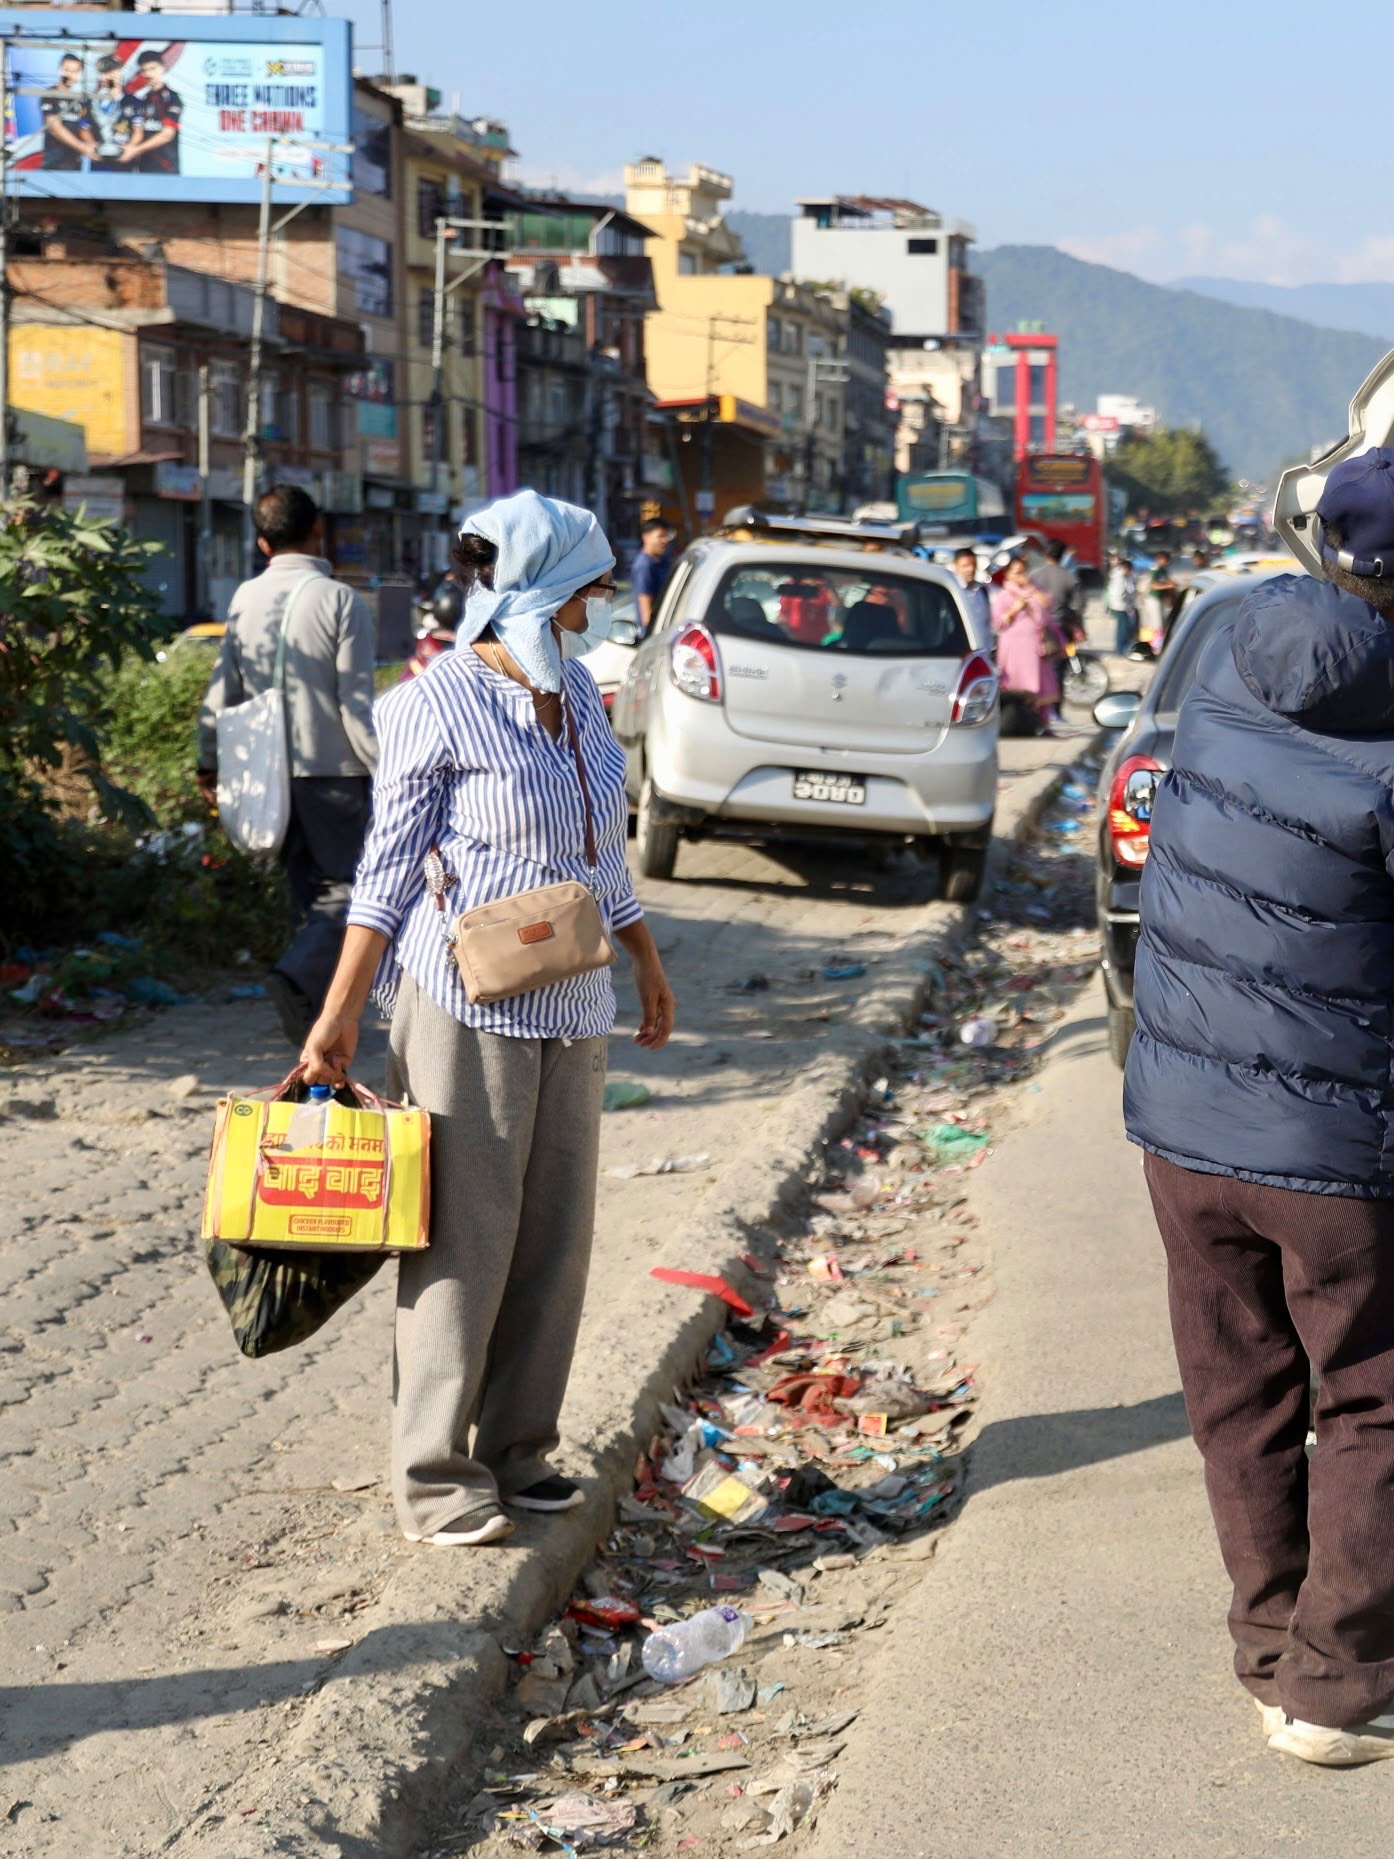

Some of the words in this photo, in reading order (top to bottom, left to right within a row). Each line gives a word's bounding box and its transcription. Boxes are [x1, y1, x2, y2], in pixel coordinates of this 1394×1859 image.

[206, 84, 248, 107] THREE
[254, 85, 316, 108] NATIONS
[219, 110, 245, 132] ONE
